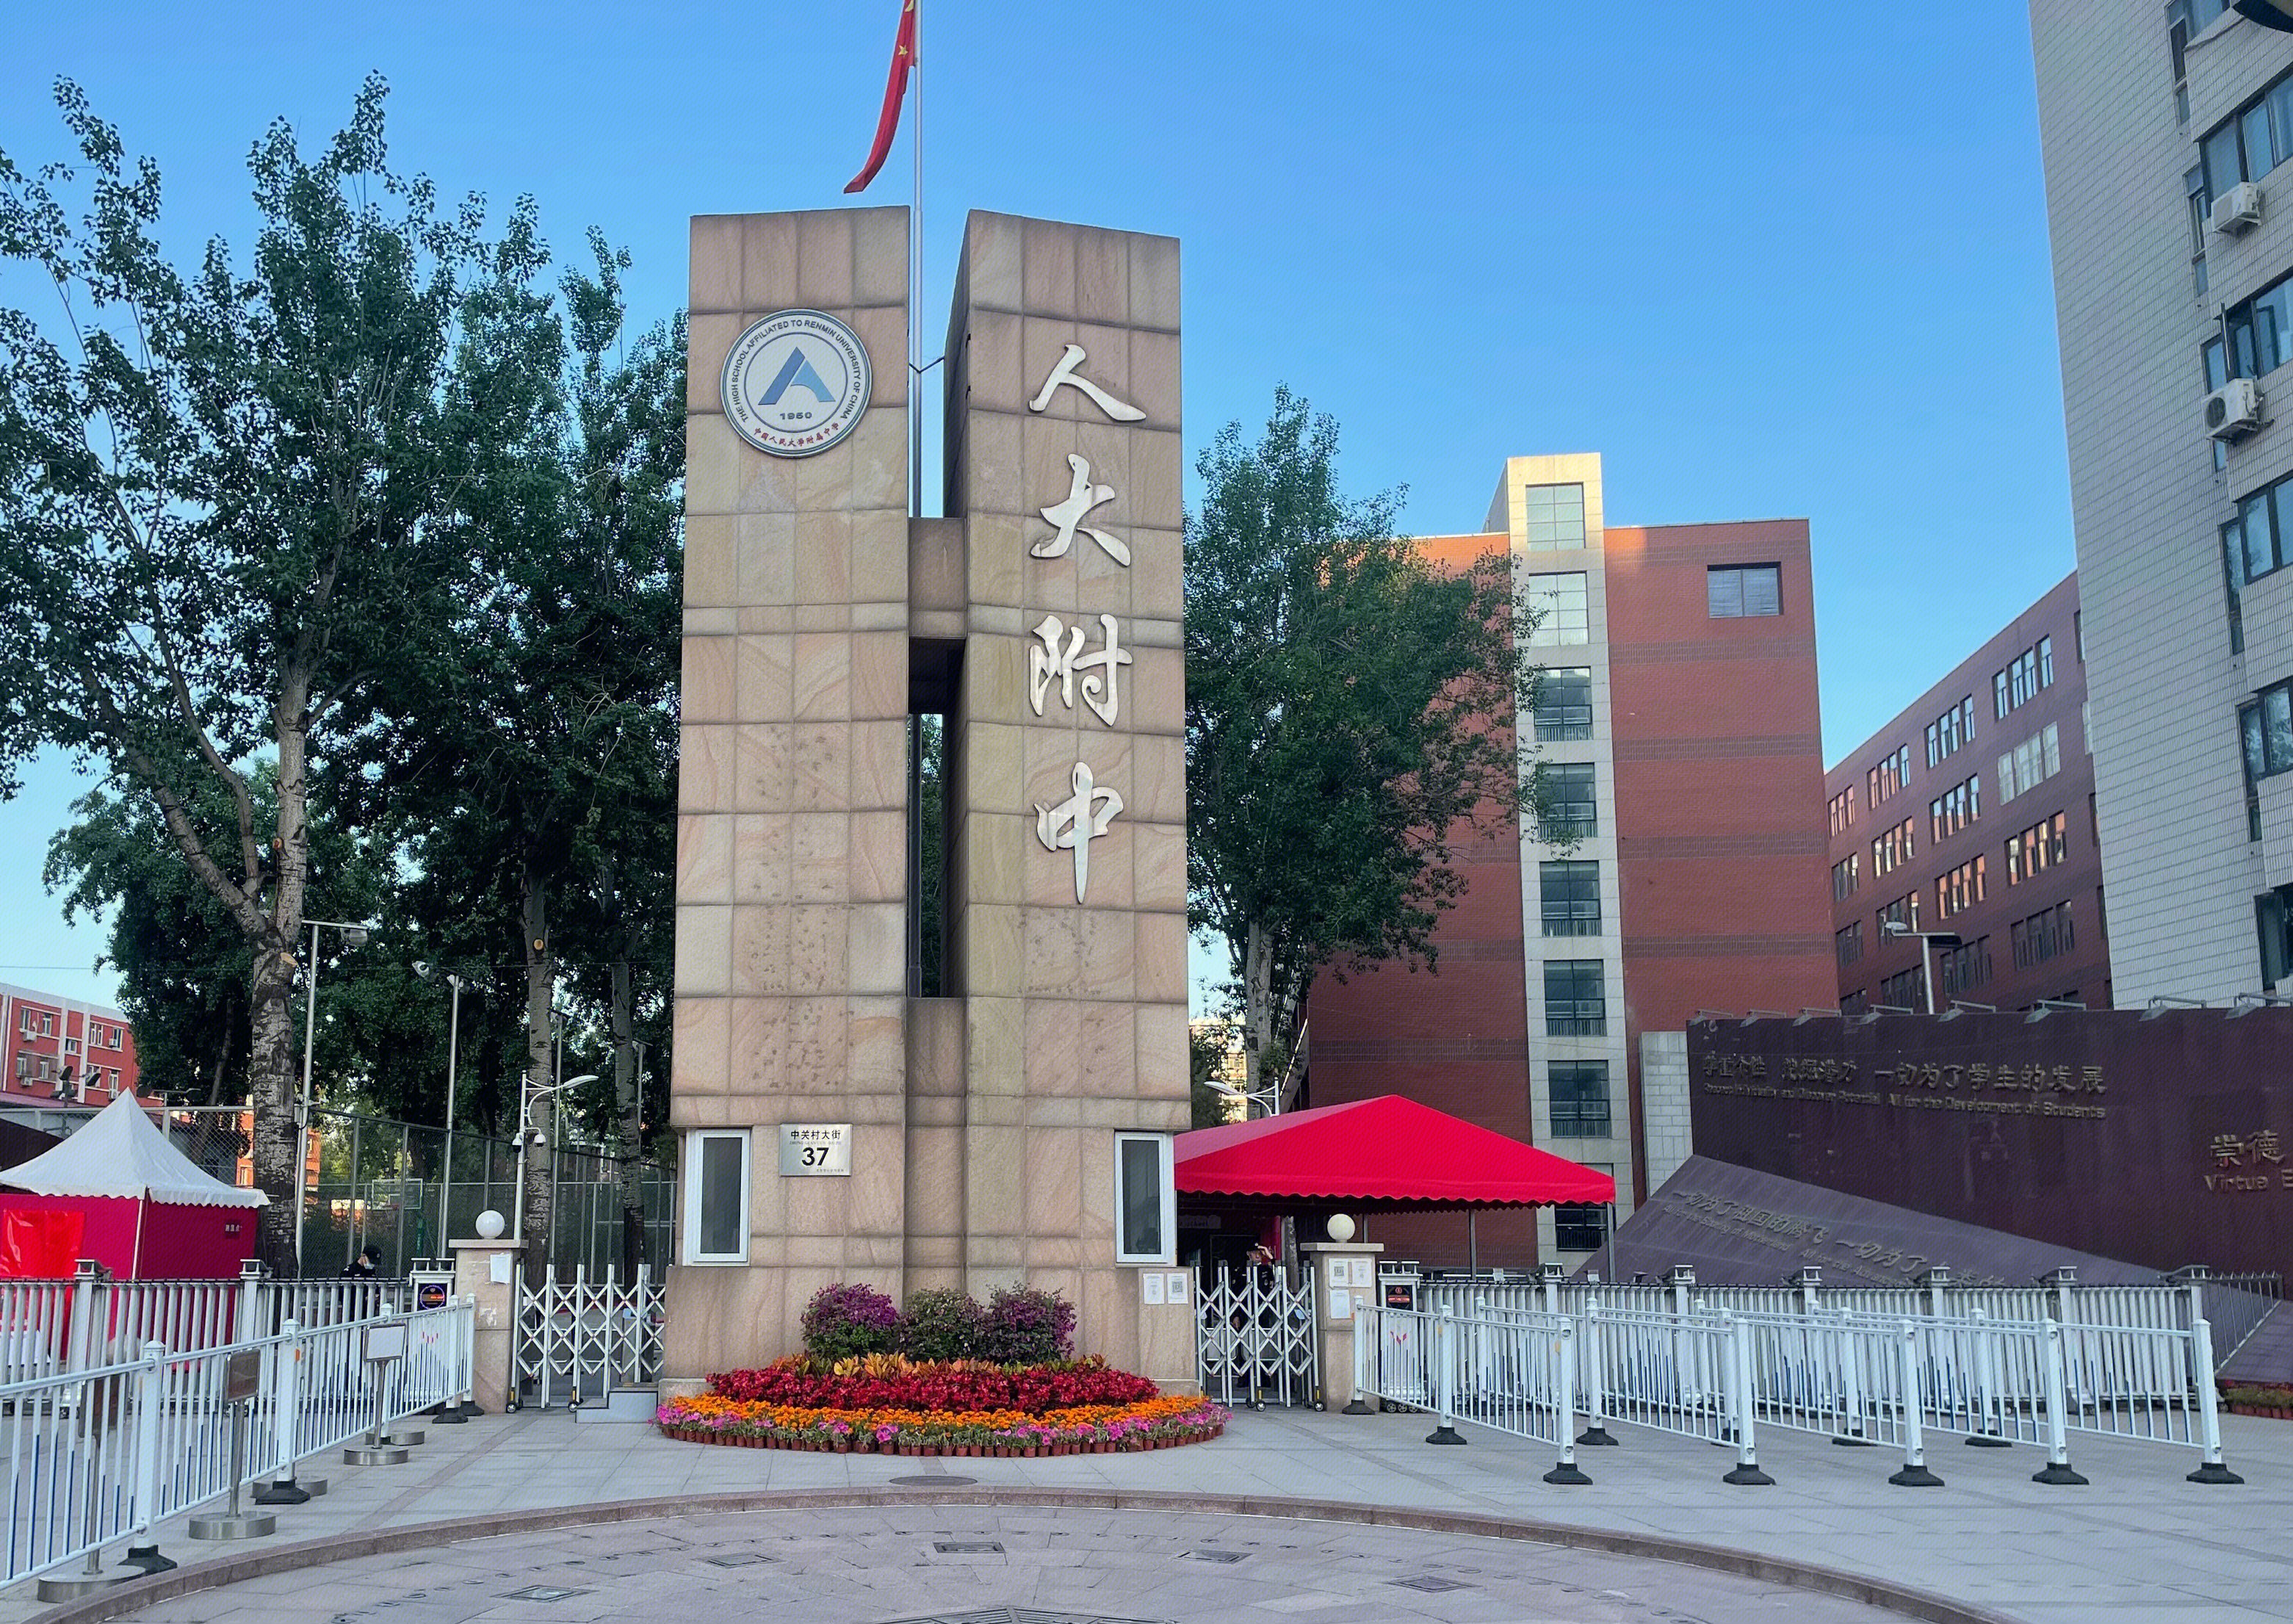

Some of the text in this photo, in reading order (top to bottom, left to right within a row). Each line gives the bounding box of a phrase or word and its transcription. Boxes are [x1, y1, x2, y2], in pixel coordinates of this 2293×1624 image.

[732, 320, 861, 422] THE HIGH SCHOOL AFFILIATED TO RENMIN UNIVERSITY OF CHINA
[779, 411, 812, 420] 1950
[1029, 343, 1147, 903] 人大附中
[1874, 1061, 2108, 1094] 一切为了学生的发展
[1904, 1094, 1921, 1108] for
[1924, 1095, 1943, 1110] the
[1946, 1096, 2022, 1114] Development
[2025, 1100, 2039, 1115] of
[2043, 1100, 2107, 1119] Students
[790, 1130, 841, 1140] 中关村大街
[2210, 1130, 2286, 1168] 崇德
[801, 1147, 829, 1166] 37
[2203, 1174, 2269, 1192] Virtue
[1672, 1191, 1830, 1244] 一切为了祖国的腾飞
